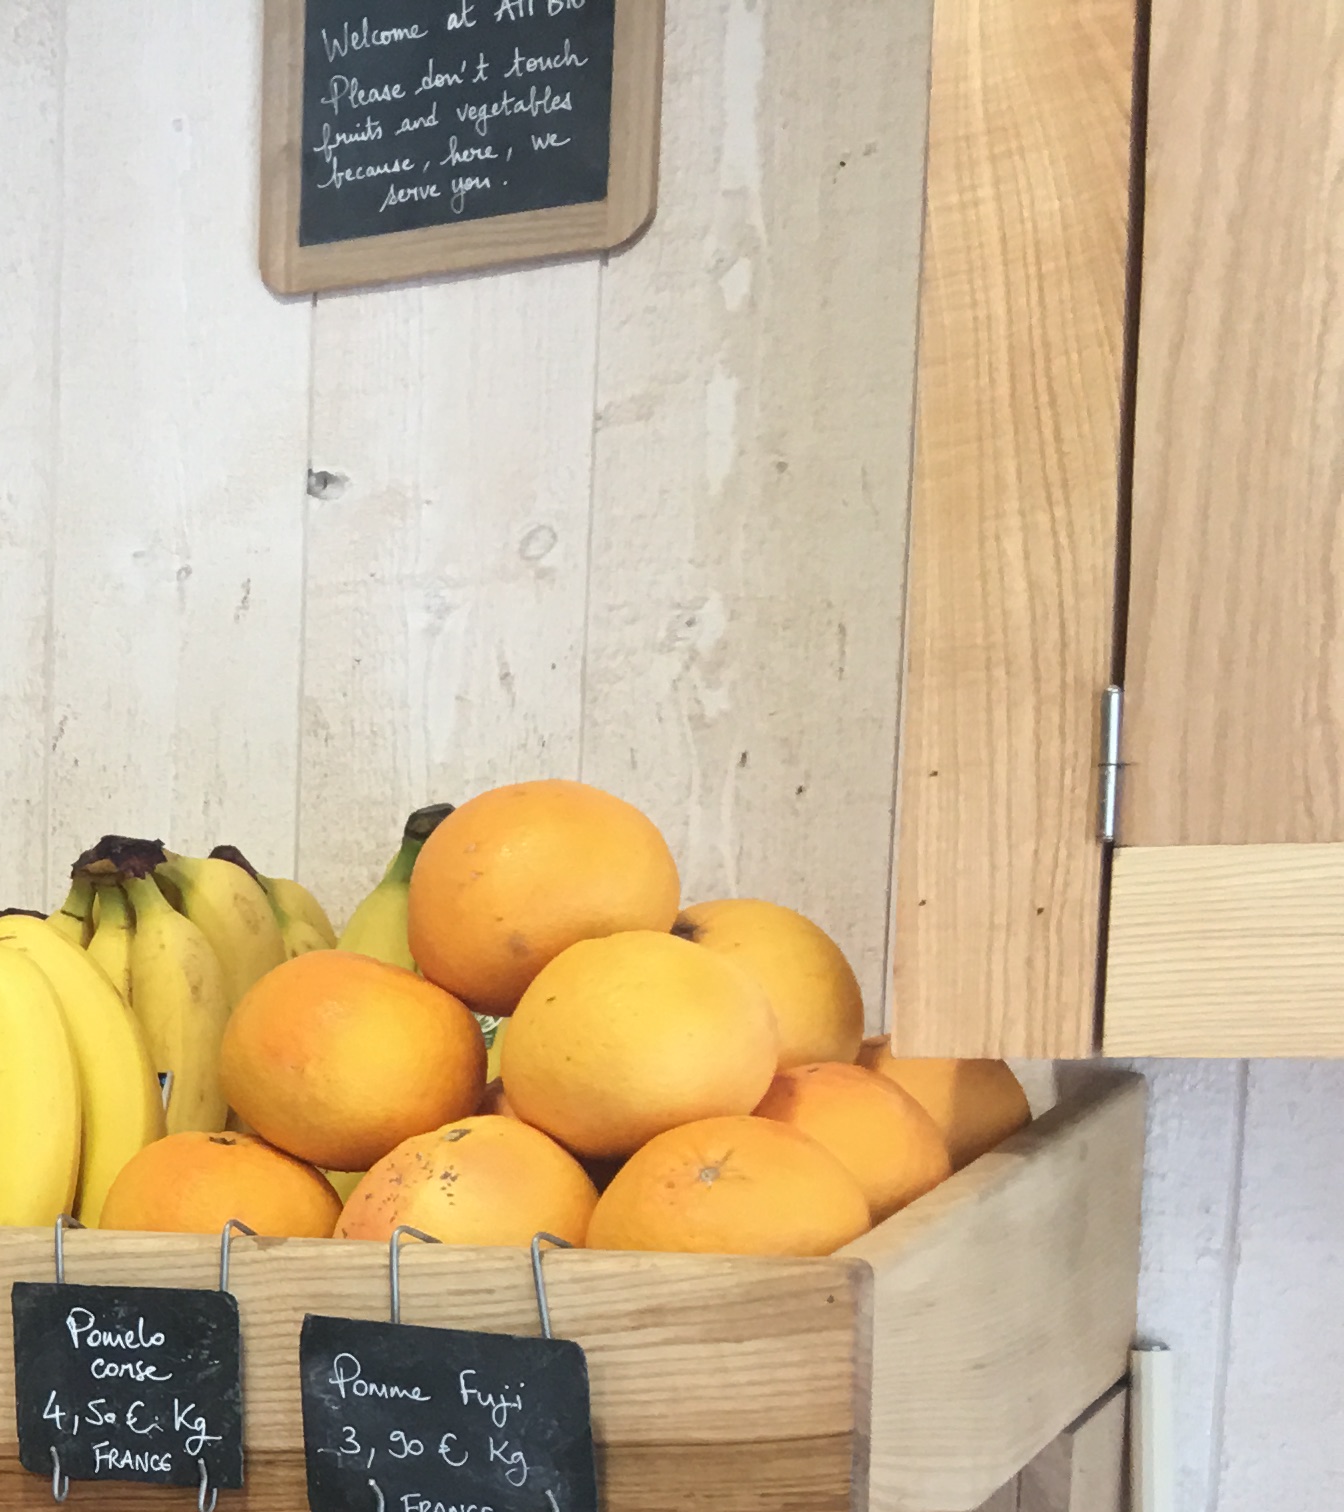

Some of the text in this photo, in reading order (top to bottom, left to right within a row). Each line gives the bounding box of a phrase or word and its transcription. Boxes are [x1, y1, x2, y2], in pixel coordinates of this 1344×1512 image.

[321, 17, 428, 62] Welcome
[447, 3, 476, 31] at
[321, 39, 589, 116] Please don't touch
[313, 85, 573, 162] fruits and vegetables
[532, 133, 571, 151] we
[379, 181, 441, 213] serve
[66, 1307, 165, 1349] Pomelo
[91, 1358, 173, 1381] corse
[329, 1353, 525, 1428] Pomme Fuji
[174, 1398, 222, 1456] Kg
[93, 1441, 172, 1474] FRANCE
